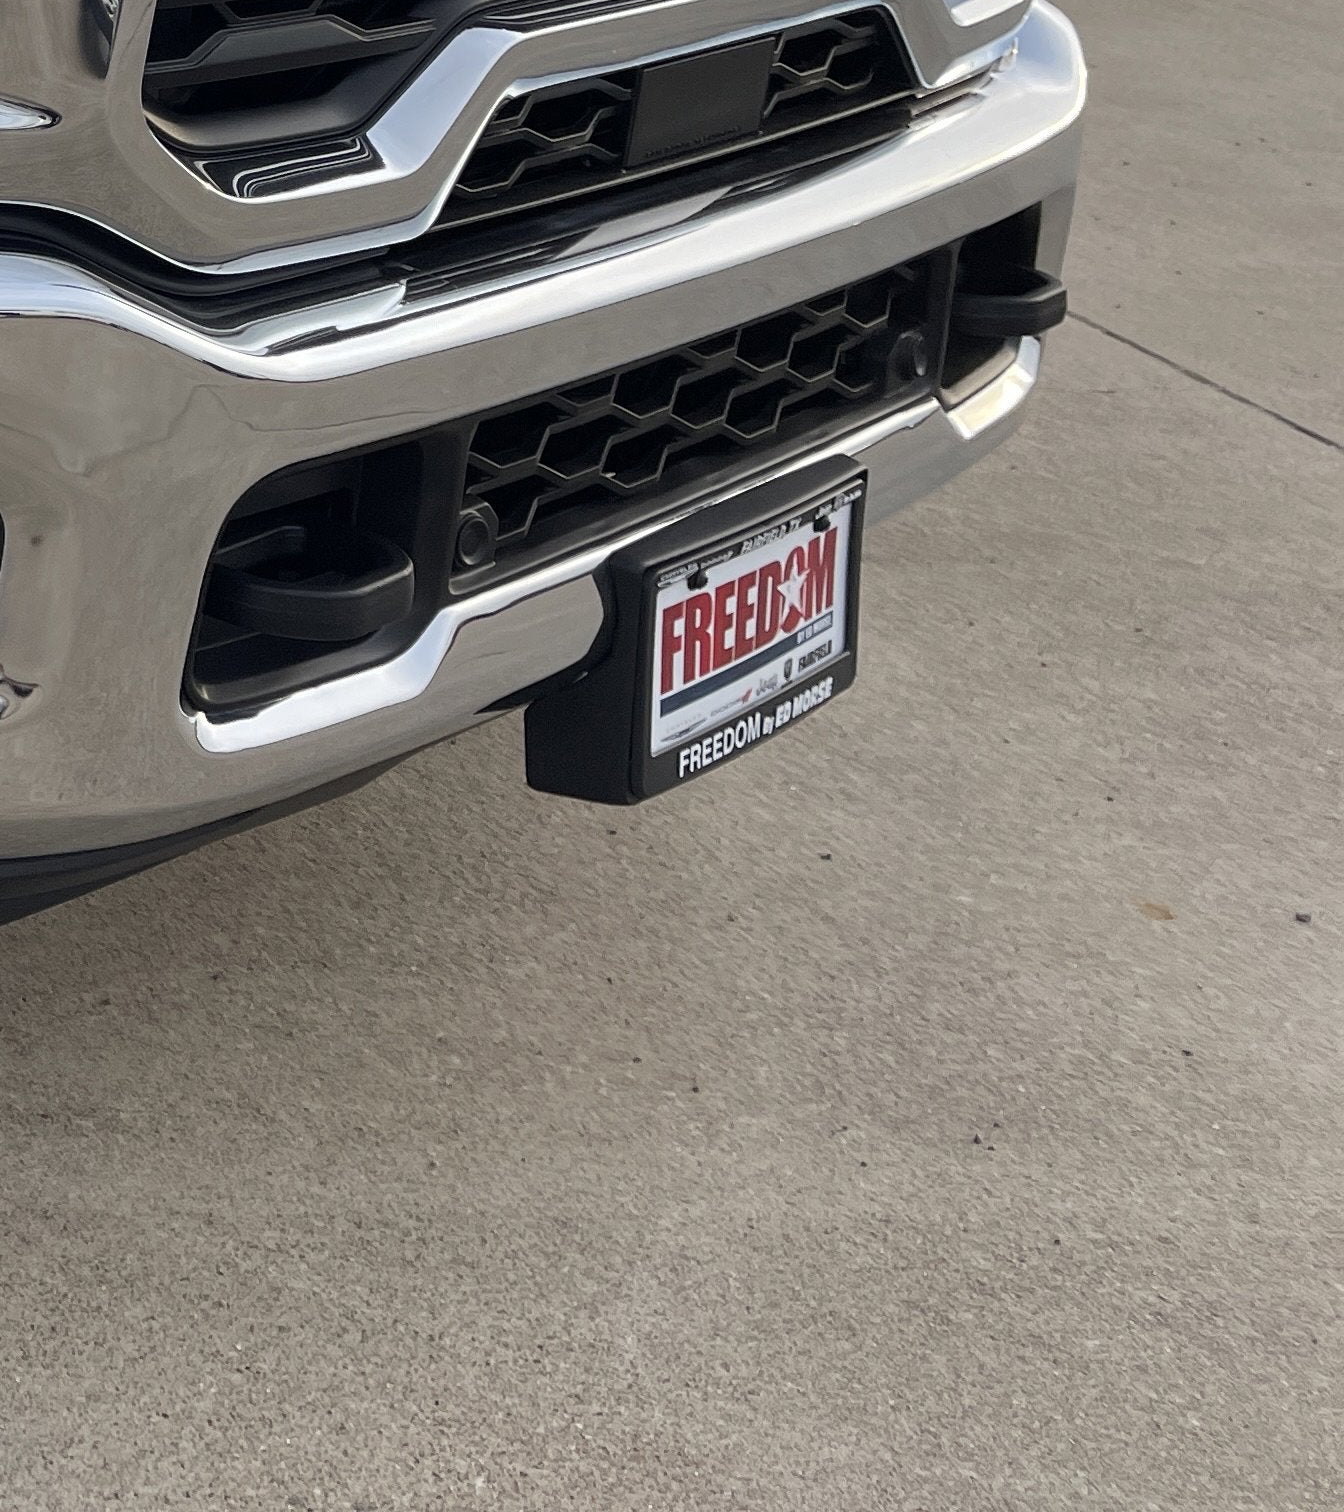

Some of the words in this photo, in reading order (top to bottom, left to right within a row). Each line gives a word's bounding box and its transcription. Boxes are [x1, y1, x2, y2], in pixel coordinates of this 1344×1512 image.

[661, 526, 839, 695] FREEDOM
[678, 711, 761, 778] FREEDOM
[775, 700, 792, 728] ED
[792, 675, 833, 719] MORSE
